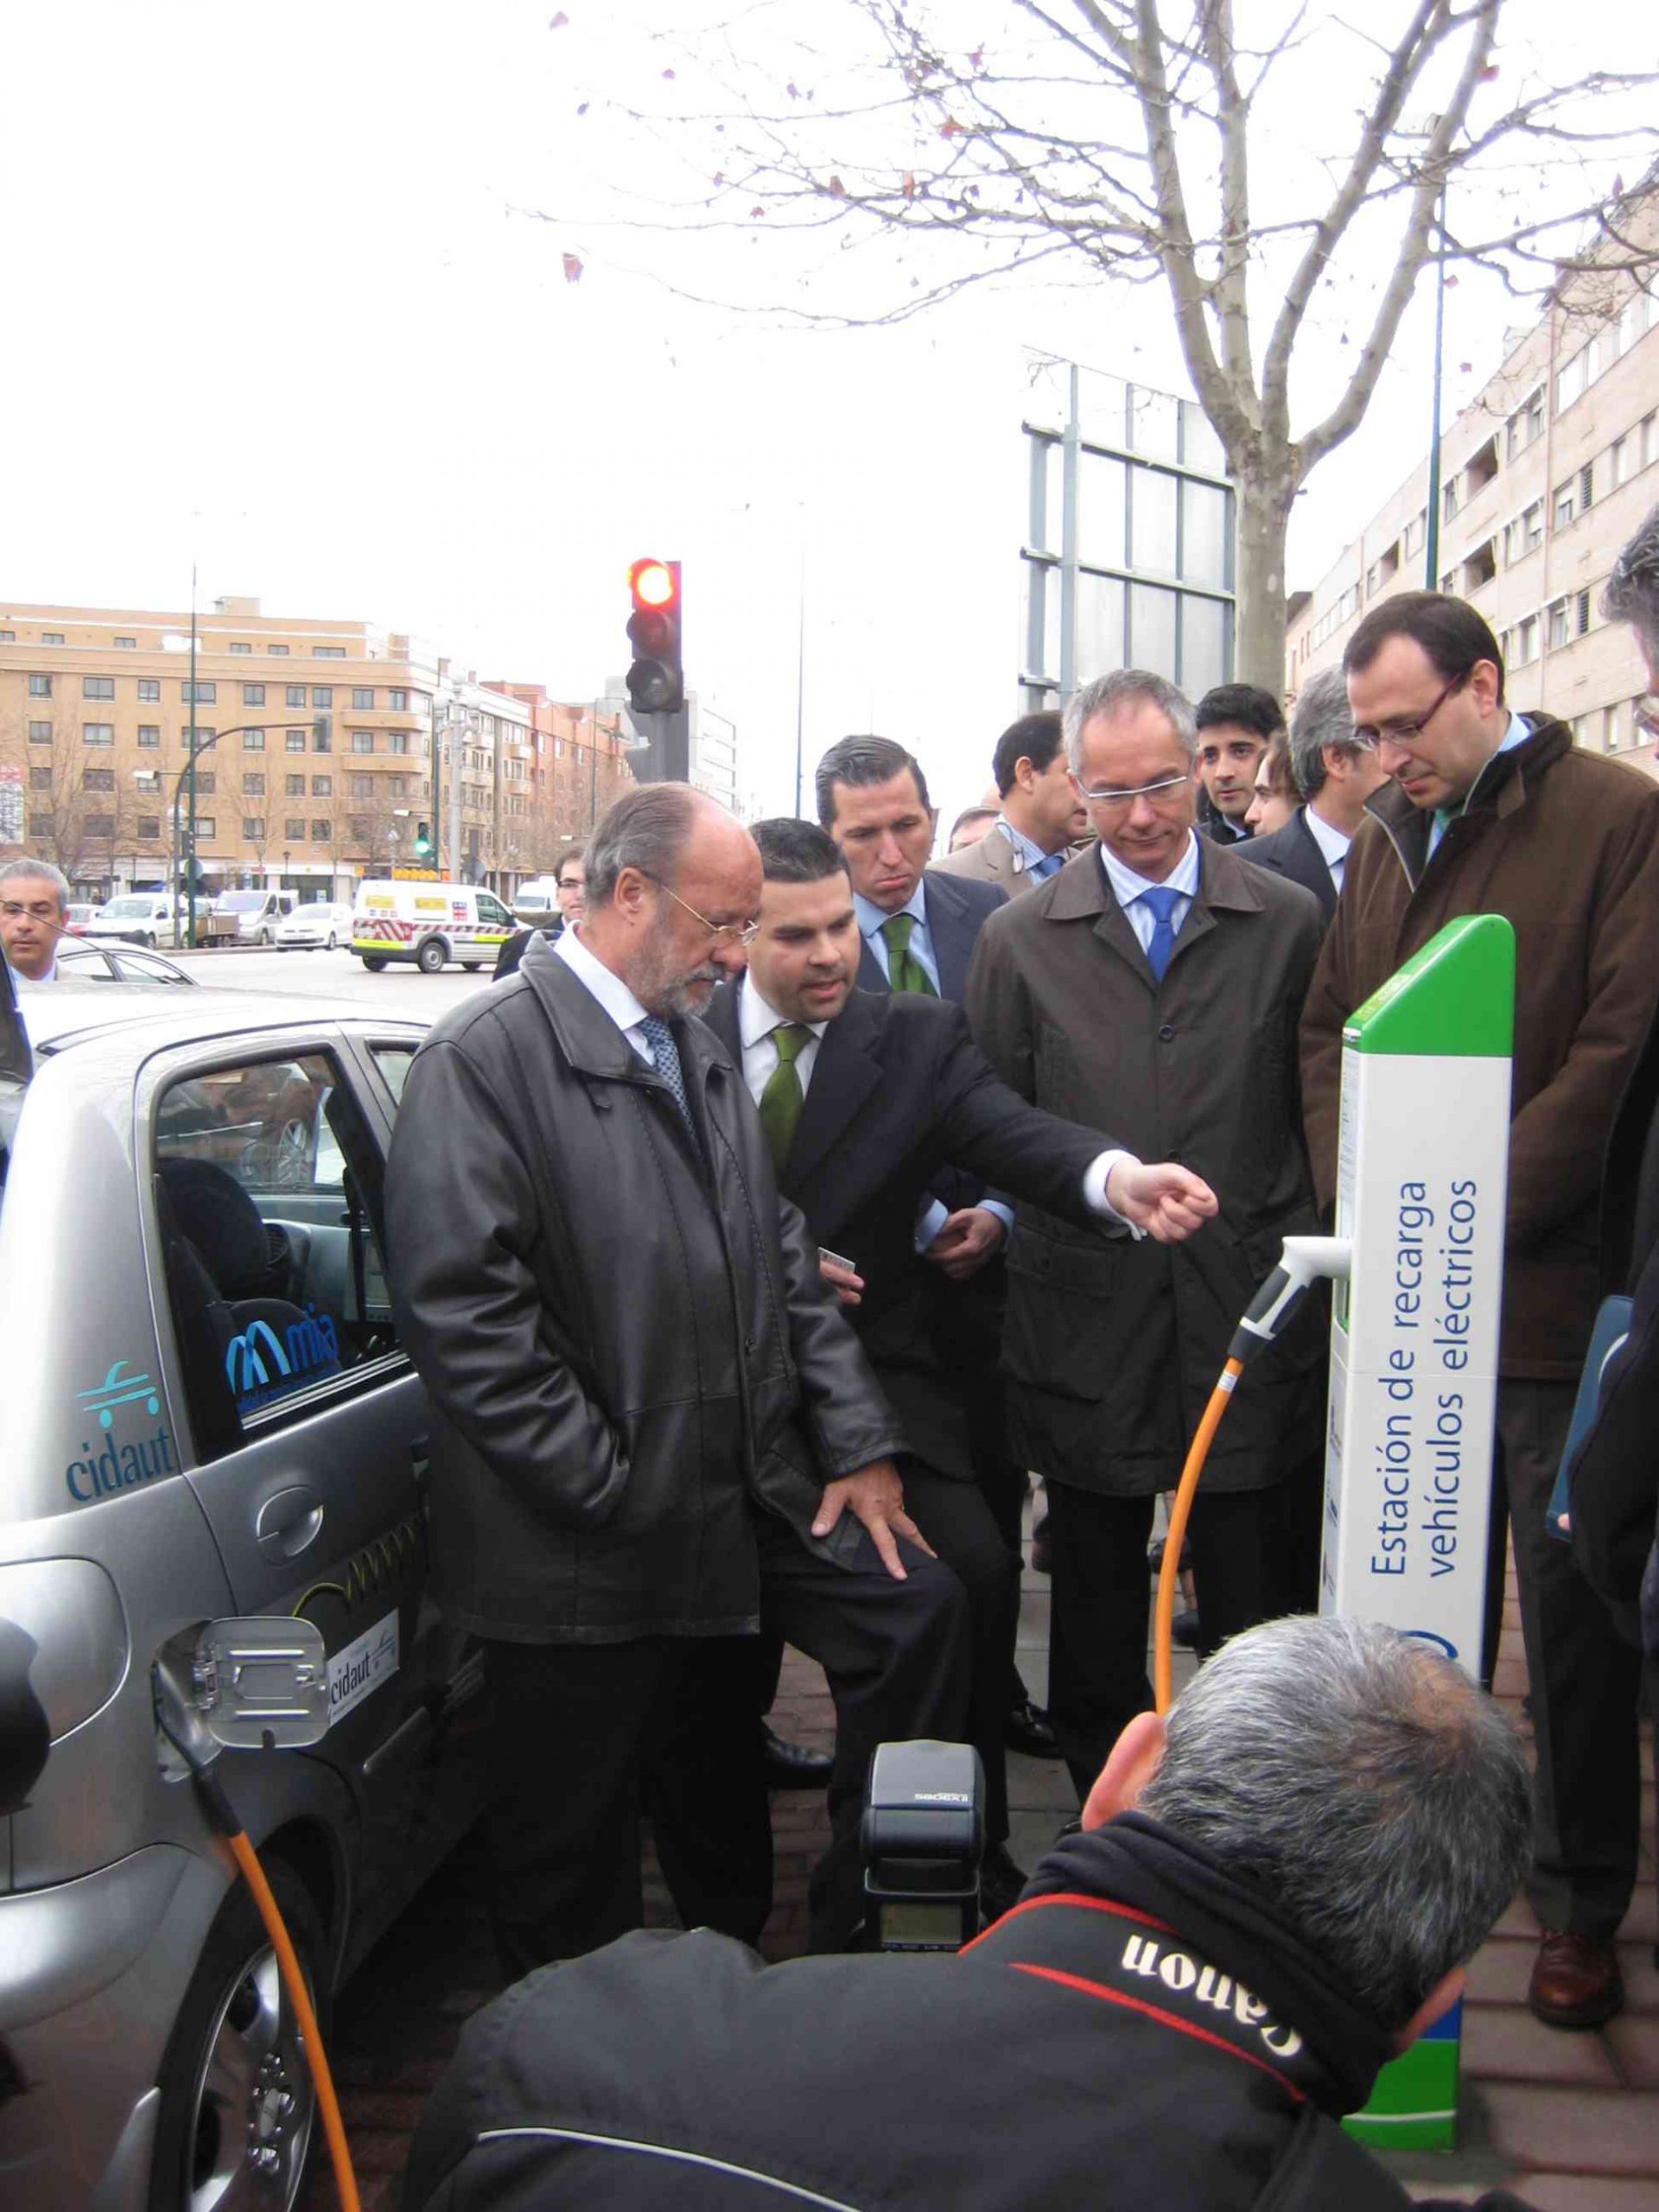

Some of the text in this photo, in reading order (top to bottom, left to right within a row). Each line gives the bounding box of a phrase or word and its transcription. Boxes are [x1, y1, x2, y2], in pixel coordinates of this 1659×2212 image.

[1371, 1182, 1434, 1574] Estación de recarga
[1421, 1180, 1477, 1578] vehículos eléctricos
[66, 1426, 174, 1502] cidaut
[331, 1651, 371, 1705] cidaut
[1122, 1934, 1302, 2057] Canon
